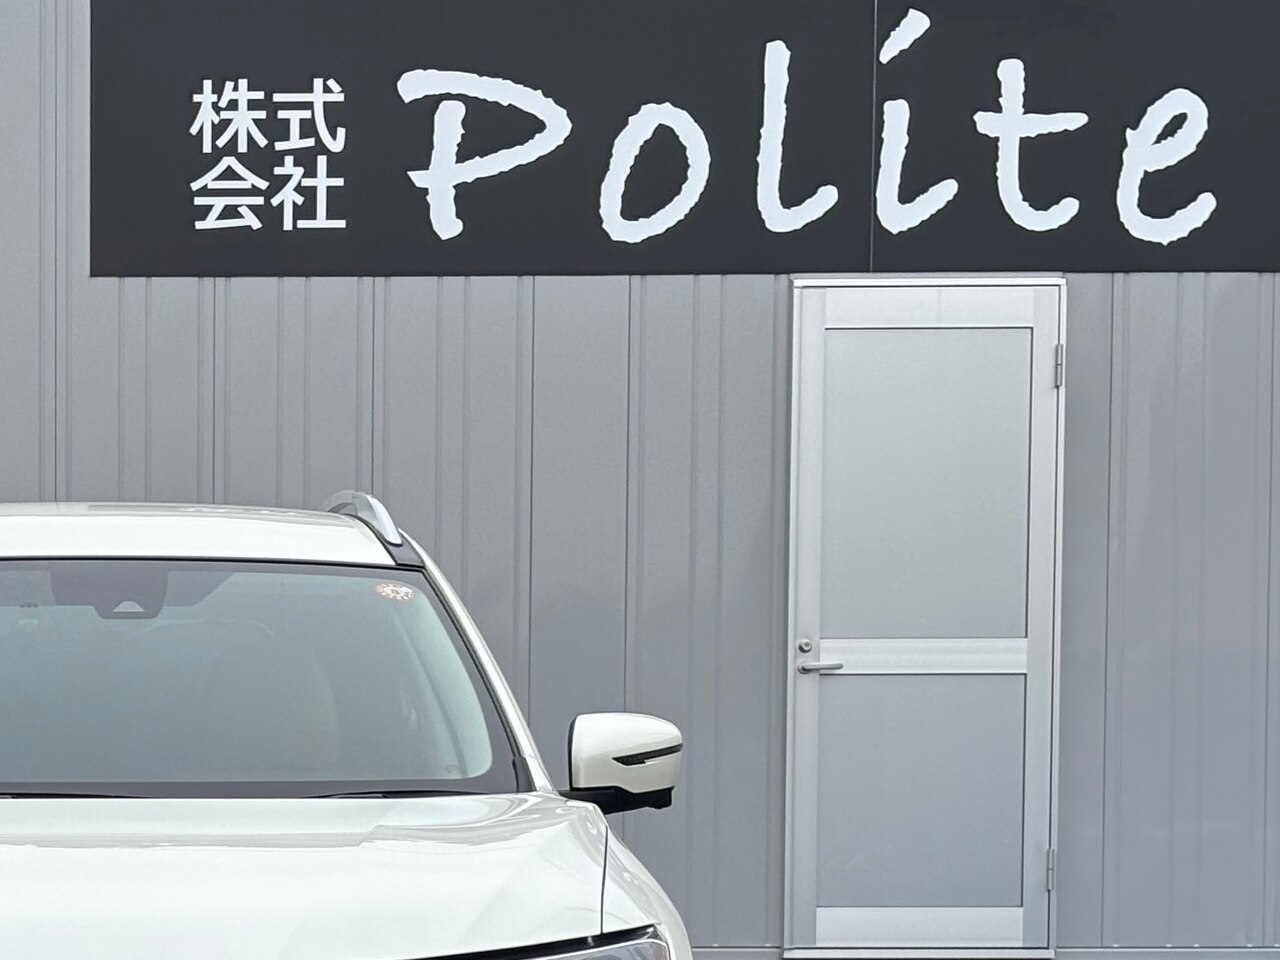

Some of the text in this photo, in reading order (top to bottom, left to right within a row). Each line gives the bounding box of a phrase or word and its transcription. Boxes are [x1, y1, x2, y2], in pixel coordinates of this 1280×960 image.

[189, 77, 346, 154] 株式
[396, 8, 1217, 246] Polite
[189, 155, 347, 231] 会社
